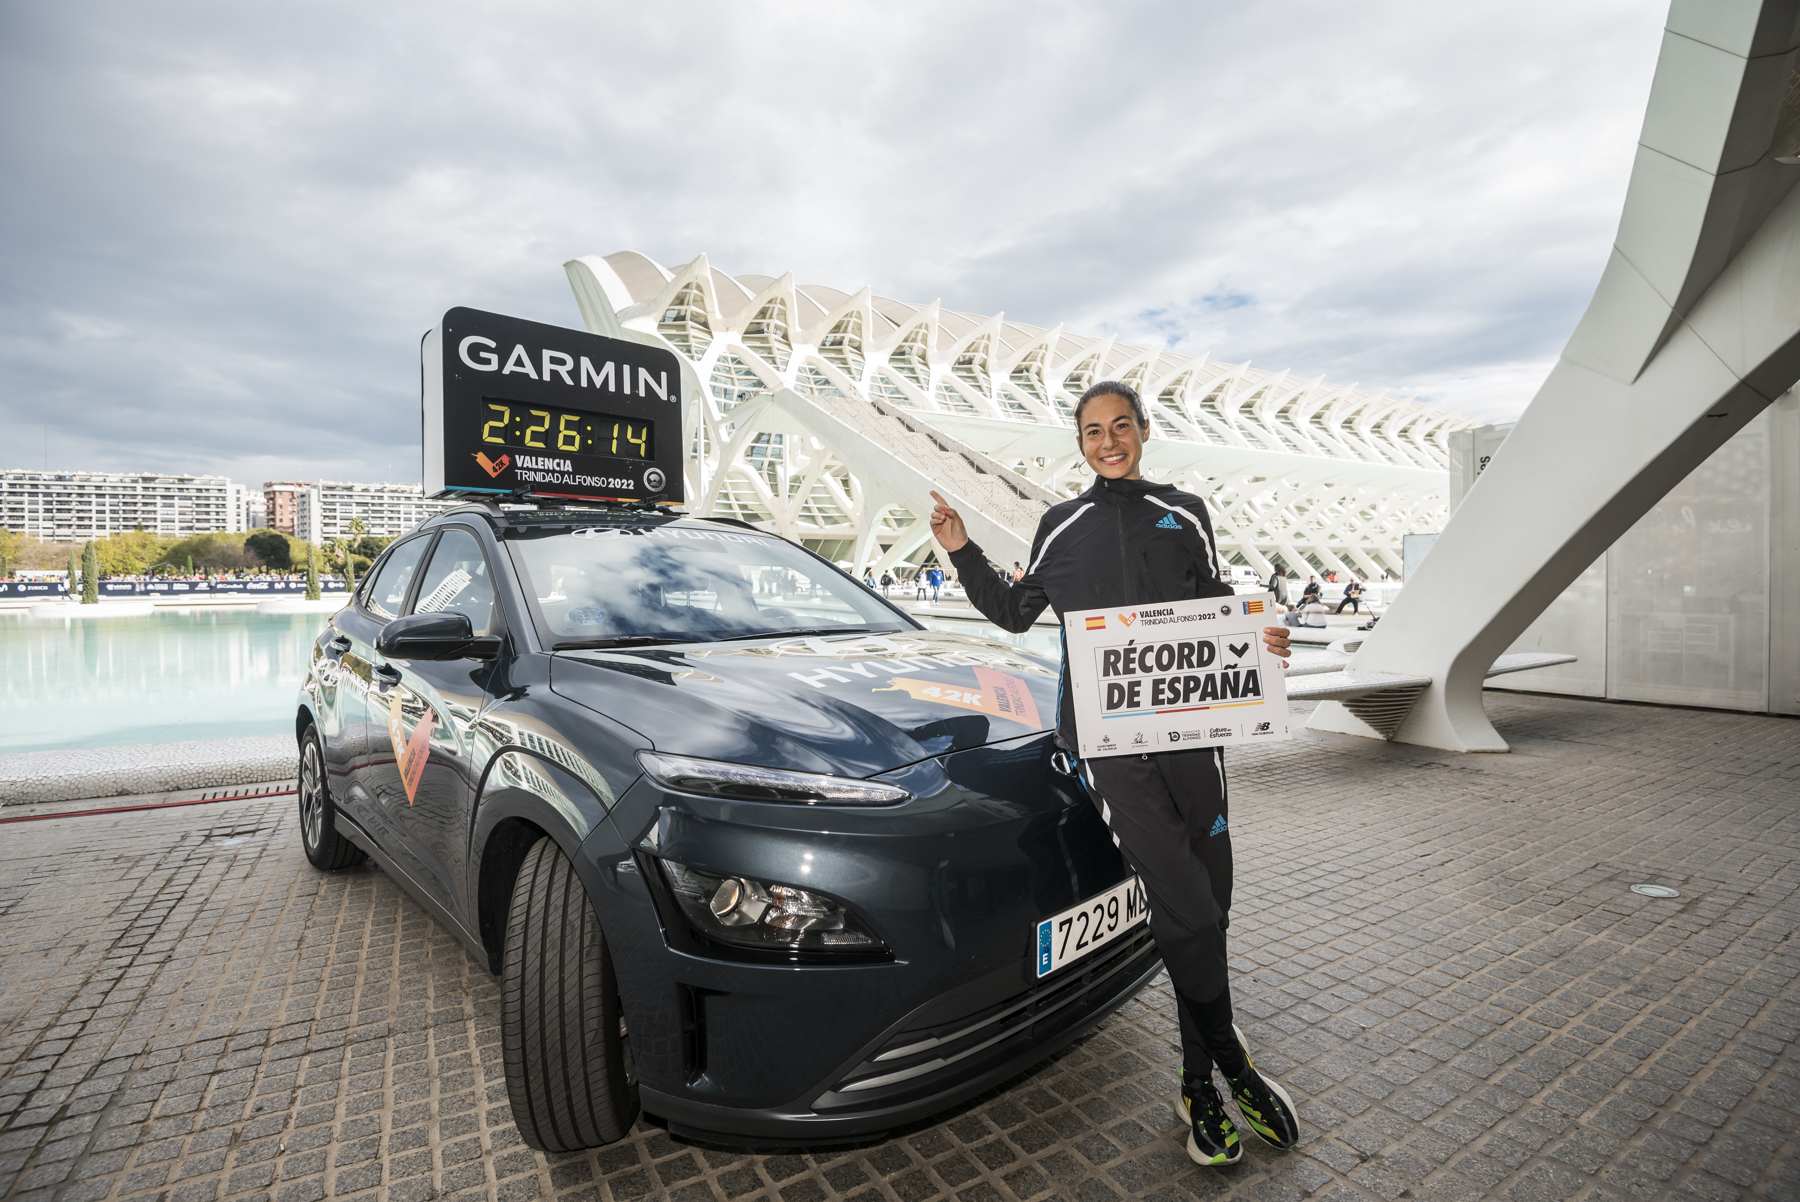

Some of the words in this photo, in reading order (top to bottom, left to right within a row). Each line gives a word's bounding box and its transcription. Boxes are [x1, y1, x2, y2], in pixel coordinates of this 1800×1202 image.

[459, 335, 668, 401] GARMIN
[482, 403, 647, 458] 2:26:14
[492, 459, 507, 474] 42K
[515, 454, 573, 472] VALENCIA
[514, 469, 561, 484] TRINIDAD
[562, 474, 607, 487] ALFONSO
[608, 477, 635, 490] 2022
[1139, 608, 1175, 619] VALENCIA
[1140, 617, 1169, 626] TRINIDAD
[1168, 614, 1198, 624] ALFONSO
[1197, 612, 1216, 621] 2022
[1102, 639, 1216, 677] RÉCORD
[921, 686, 984, 707] 42K
[1106, 680, 1142, 711] DE
[1151, 664, 1262, 707] ESPAÑA
[993, 686, 1012, 713] VALENCIA
[391, 718, 405, 762] 42K
[1209, 824, 1228, 837] adida
[1058, 895, 1120, 961] 7229
[1042, 952, 1049, 966] E
